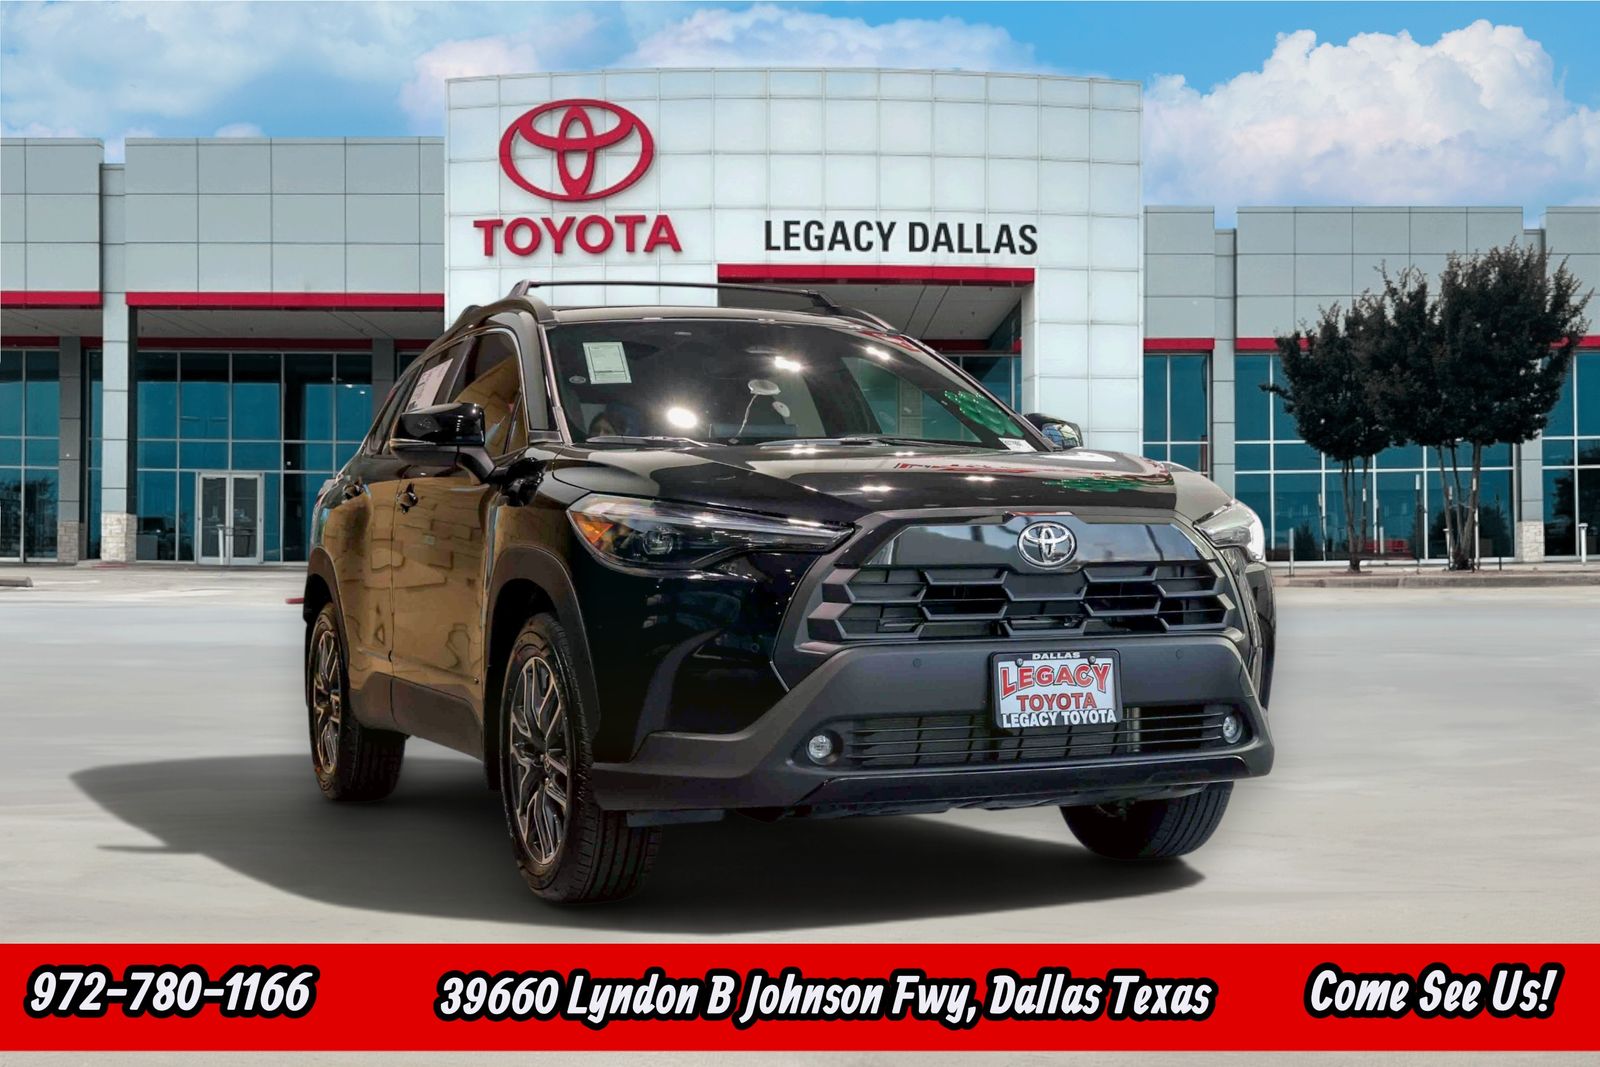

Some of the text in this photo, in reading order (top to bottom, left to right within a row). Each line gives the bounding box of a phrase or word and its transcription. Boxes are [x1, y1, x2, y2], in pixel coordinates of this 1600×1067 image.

[473, 213, 683, 257] TOYOTA
[764, 220, 1038, 256] LEGACY DALLAS
[1032, 651, 1081, 660] DALLAS
[999, 663, 1112, 700] LEGACY
[1016, 692, 1098, 712] TOYOTA
[1002, 708, 1117, 729] LEGACY TOYOTA
